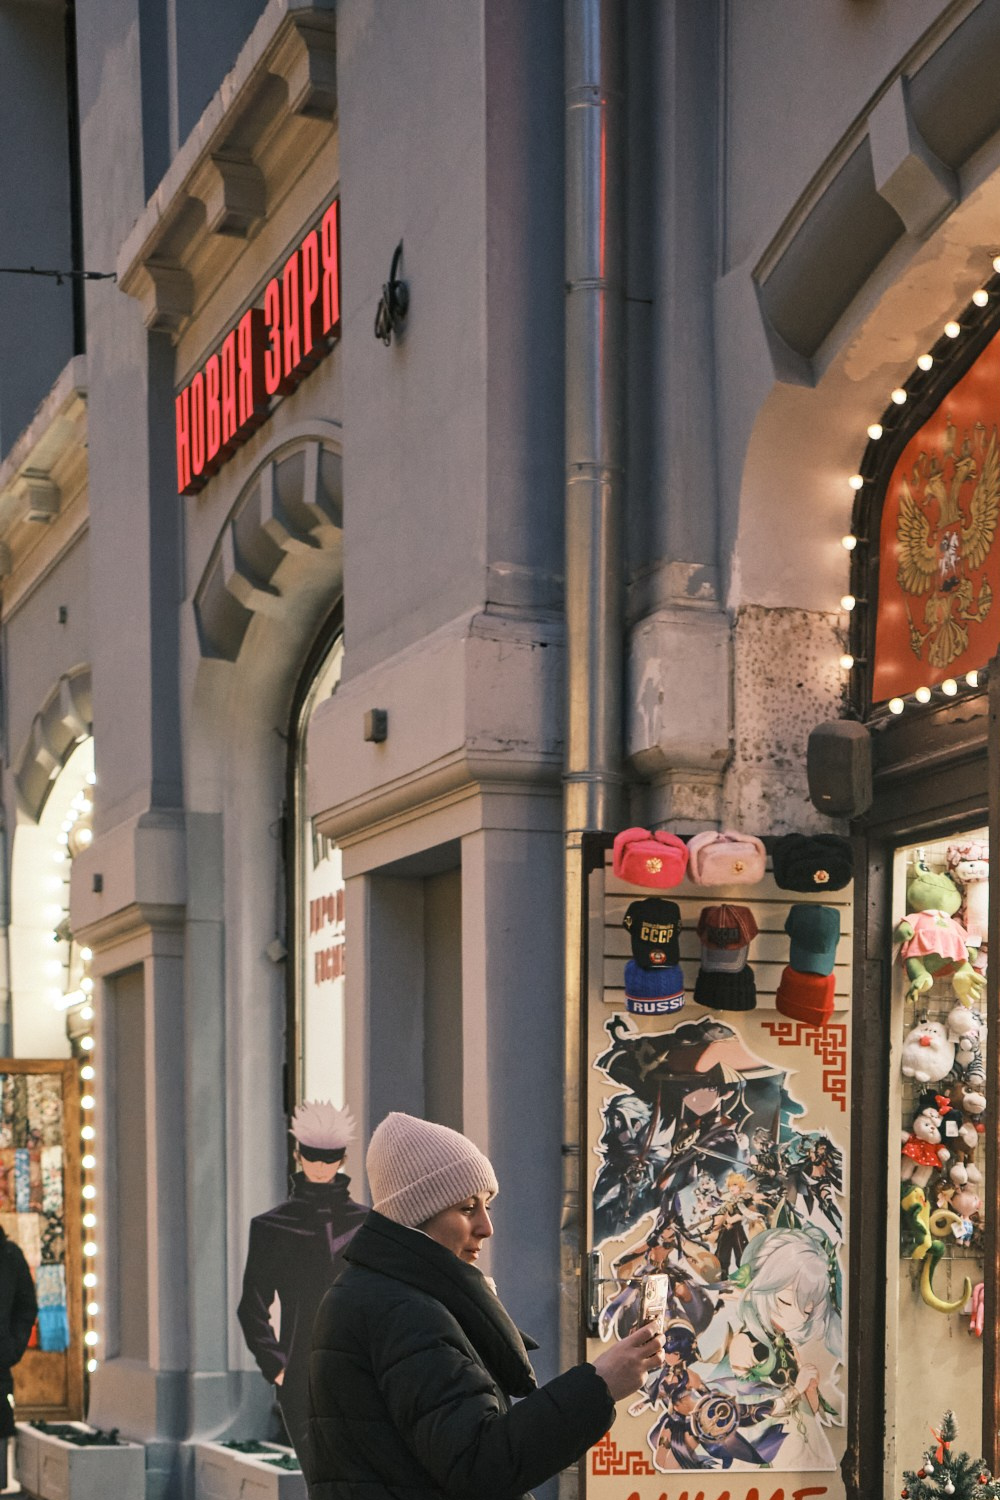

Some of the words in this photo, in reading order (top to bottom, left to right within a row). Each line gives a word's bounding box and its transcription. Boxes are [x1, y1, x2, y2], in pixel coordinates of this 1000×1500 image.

[175, 309, 254, 495] НОВАЯ
[264, 199, 340, 395] ЗАРЯ
[640, 926, 674, 944] СССР
